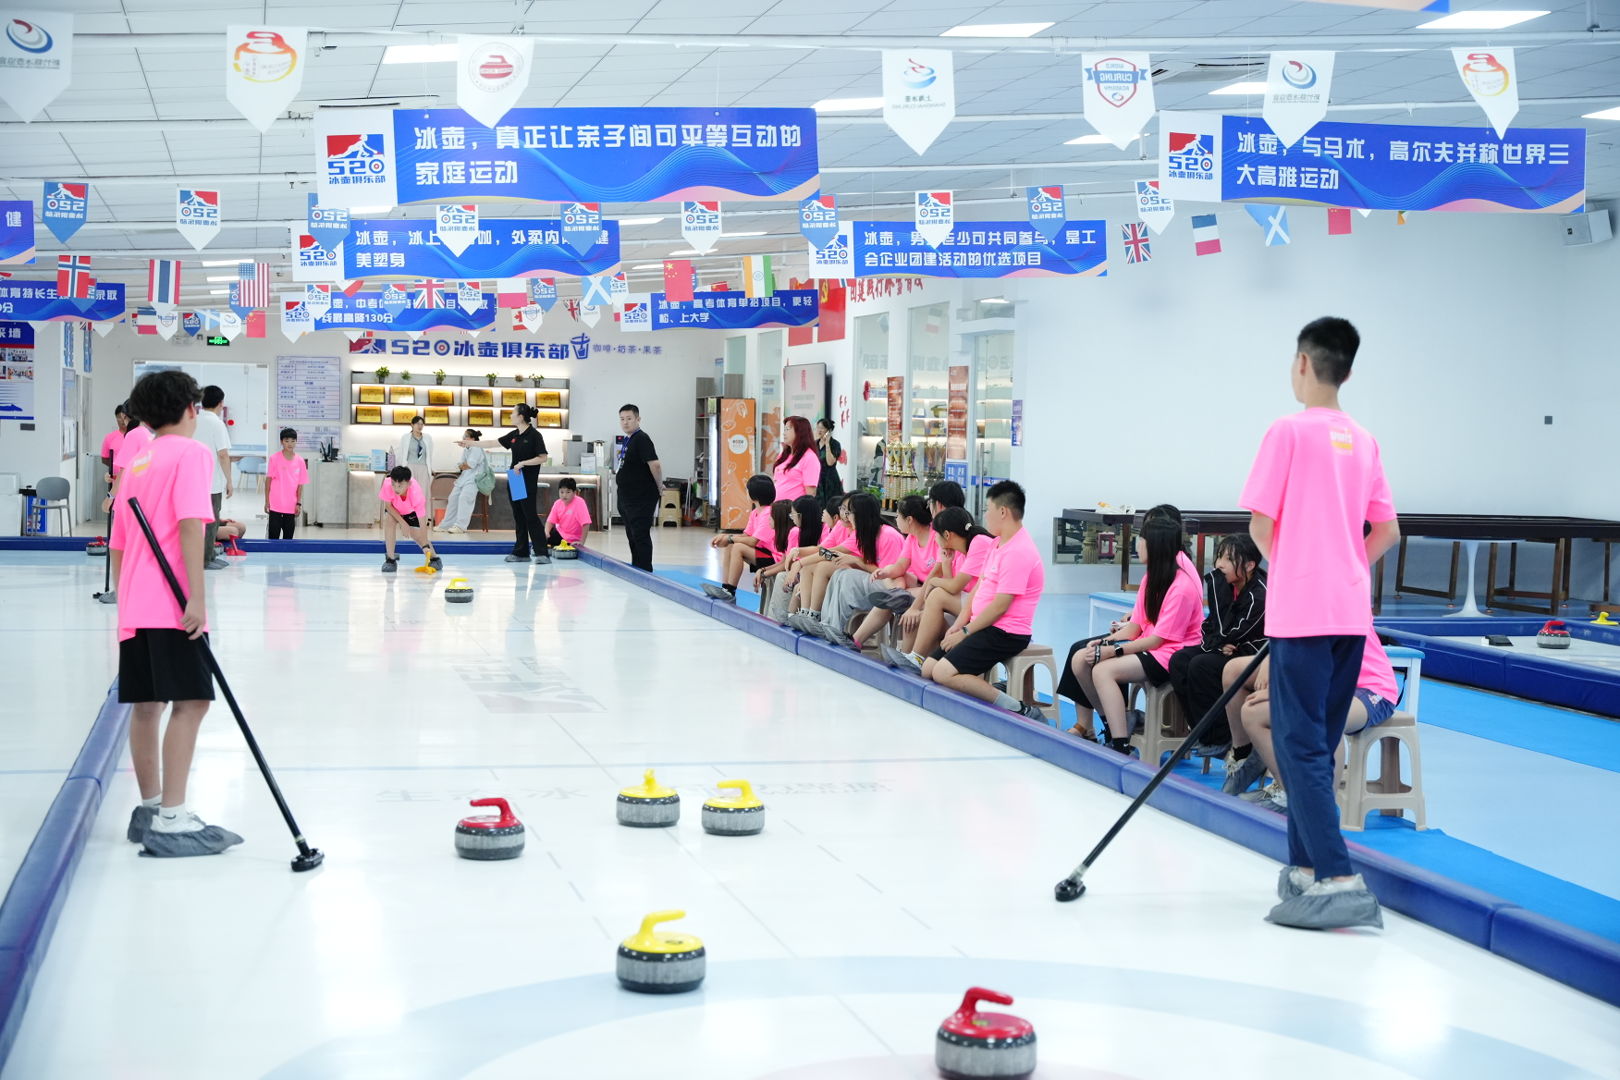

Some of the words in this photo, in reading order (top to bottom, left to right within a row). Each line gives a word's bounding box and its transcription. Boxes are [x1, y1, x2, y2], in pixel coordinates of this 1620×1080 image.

[414, 125, 801, 150] 冰壶，真正让亲子间可平等互动的
[1237, 131, 1569, 165] 冰壶，与马术，高尔夫并称世界三
[328, 159, 385, 175] 520
[1169, 155, 1214, 171] 520
[328, 176, 386, 185] 冰壶俱乐部
[415, 161, 519, 185] 家庭运动
[1236, 163, 1339, 190] 大高雅运动
[6, 211, 22, 228] 健
[355, 253, 406, 268] 美塑身
[864, 251, 1041, 267] 会企业团建活动的优选项目
